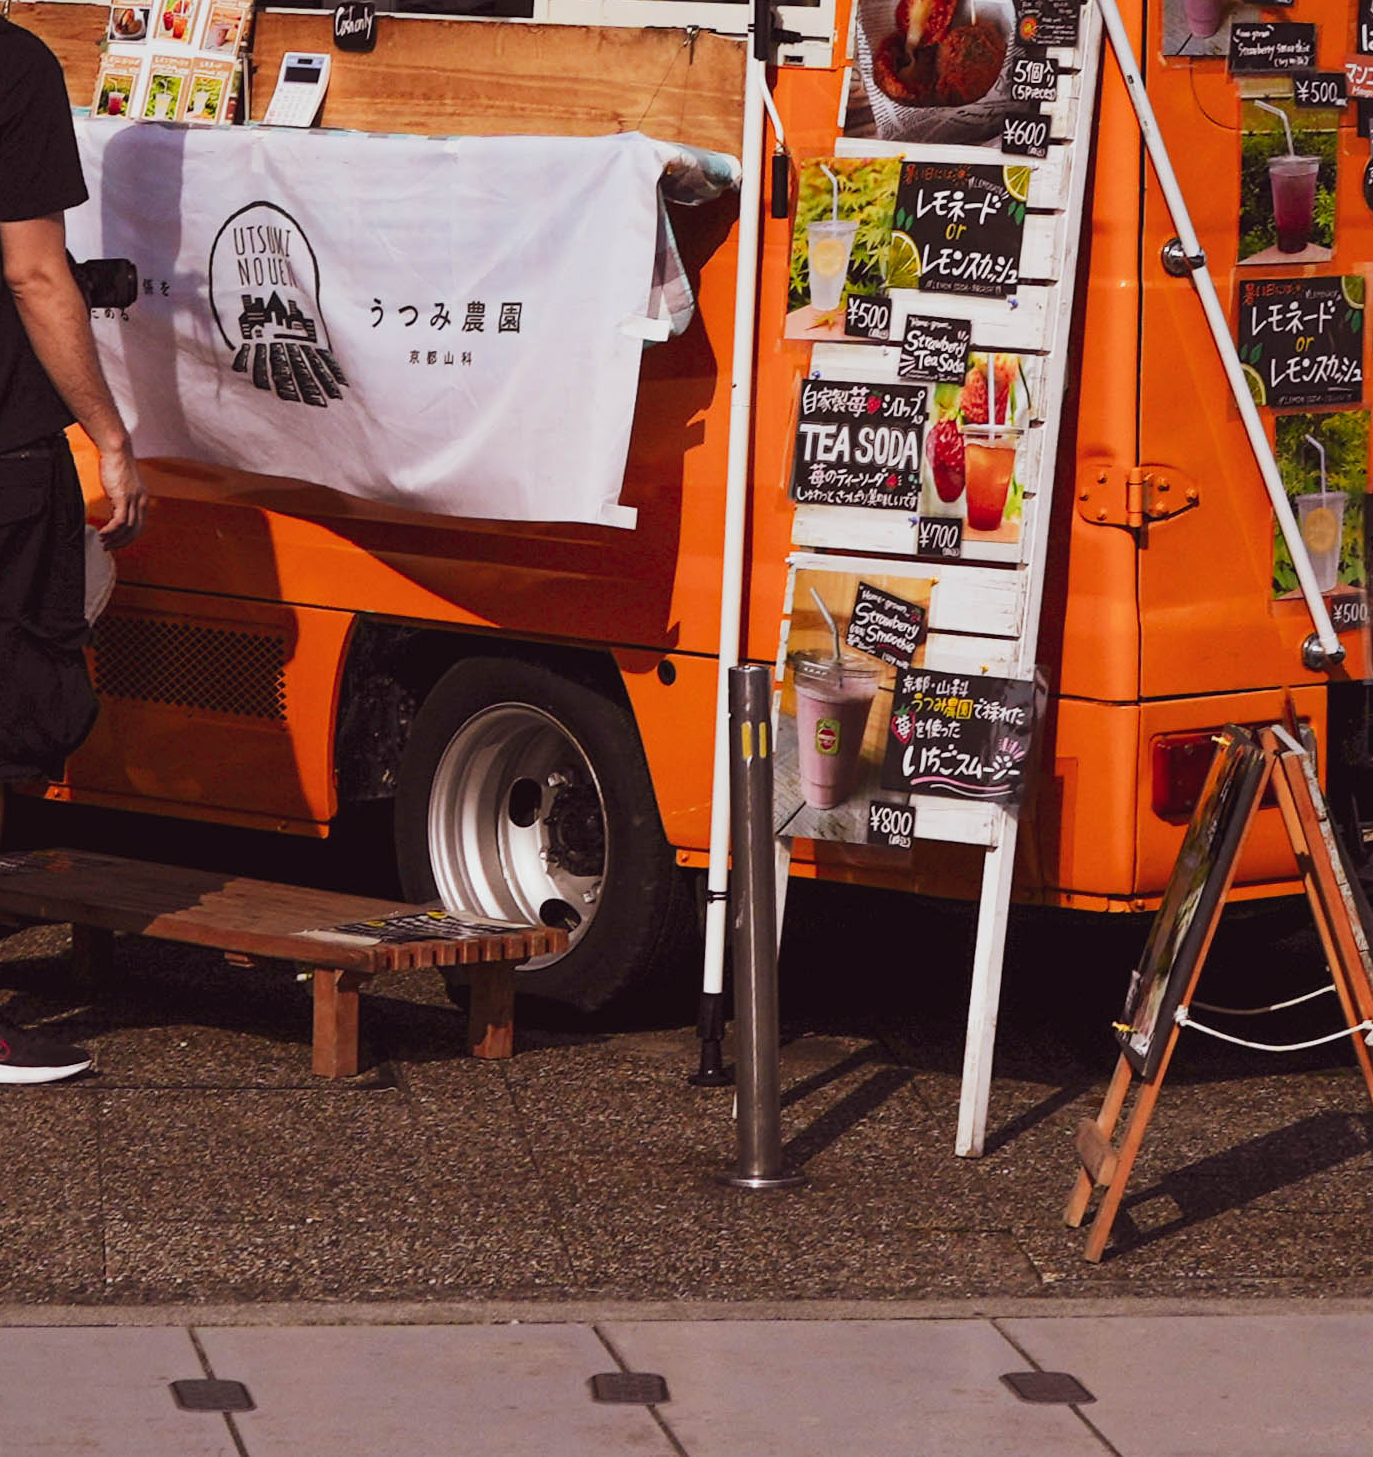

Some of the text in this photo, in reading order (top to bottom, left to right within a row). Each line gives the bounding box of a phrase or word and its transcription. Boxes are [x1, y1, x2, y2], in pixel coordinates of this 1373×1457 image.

[1013, 58, 1056, 89] 5個入り
[1296, 80, 1338, 103] ¥500
[1003, 118, 1047, 147] ¥600
[916, 188, 1003, 226] レモネード
[233, 226, 293, 256] UTSUMI
[946, 223, 967, 241] or
[922, 243, 1019, 286] レモンスカッシュ
[368, 298, 524, 334] うつみ農園
[847, 298, 889, 327] ¥500
[1251, 299, 1336, 337] レモネード
[408, 349, 473, 367] 京都山科
[1295, 336, 1315, 352] or
[913, 350, 966, 375] Tea Soda
[1270, 353, 1363, 388] レモンスカッシュ
[882, 389, 926, 418] シロップ
[799, 423, 919, 471] TEA SODA
[919, 519, 960, 549] ¥700
[1332, 603, 1368, 624] ¥500
[902, 675, 970, 695] 京都・山科
[902, 744, 1021, 781] いちごスムージー
[870, 805, 912, 835] ¥800
